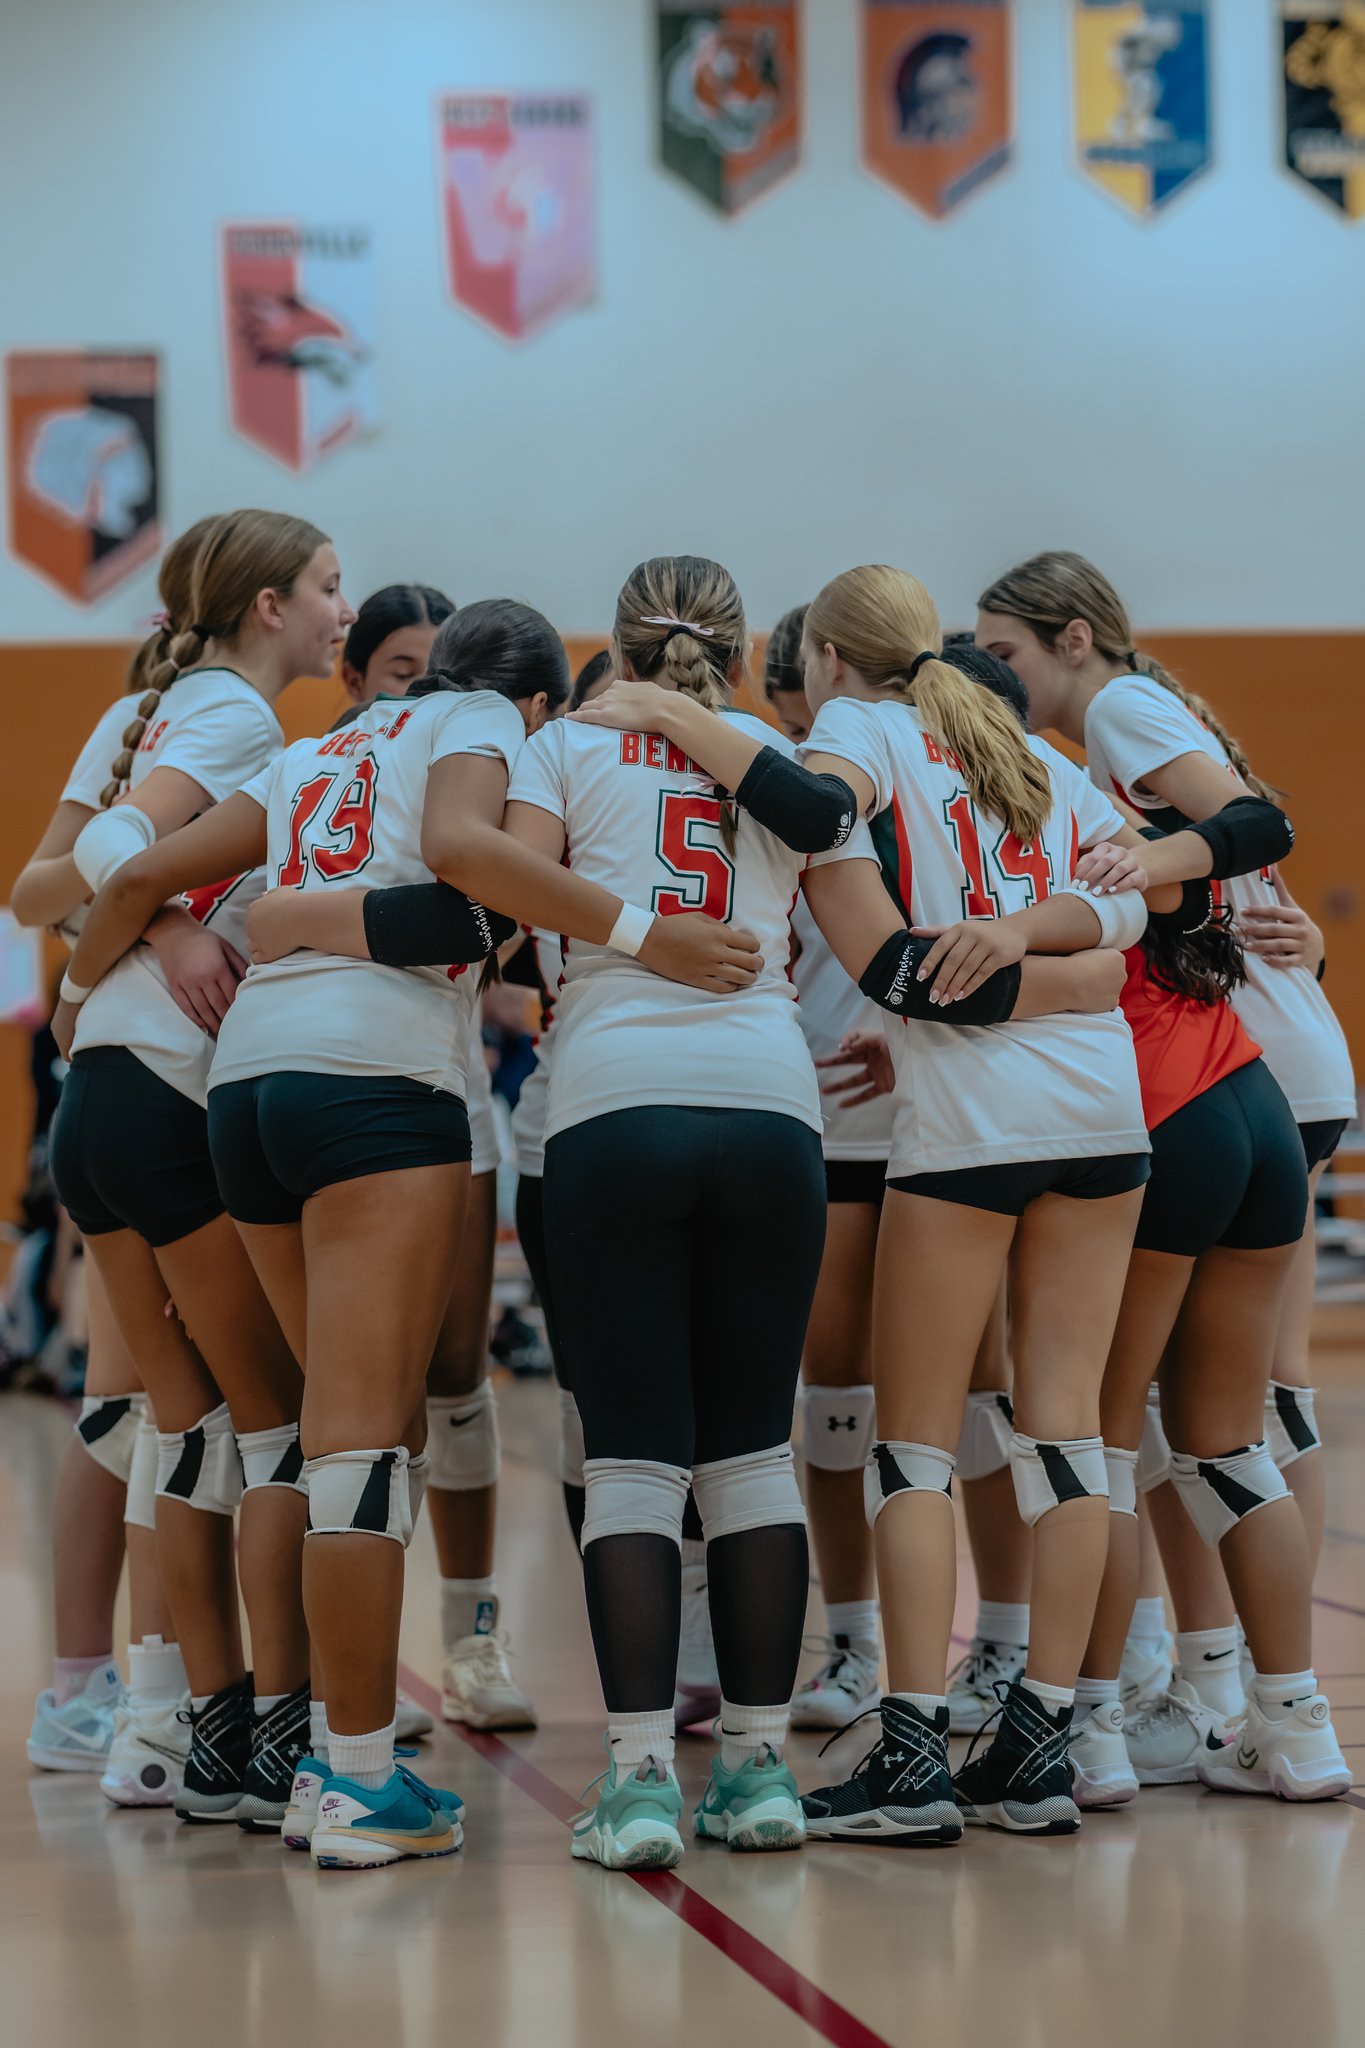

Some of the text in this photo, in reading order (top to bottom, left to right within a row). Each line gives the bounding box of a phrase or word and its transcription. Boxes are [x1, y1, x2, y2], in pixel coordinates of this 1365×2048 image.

[277, 750, 380, 889] 19
[651, 788, 739, 924] 5
[942, 786, 1055, 920] 14
